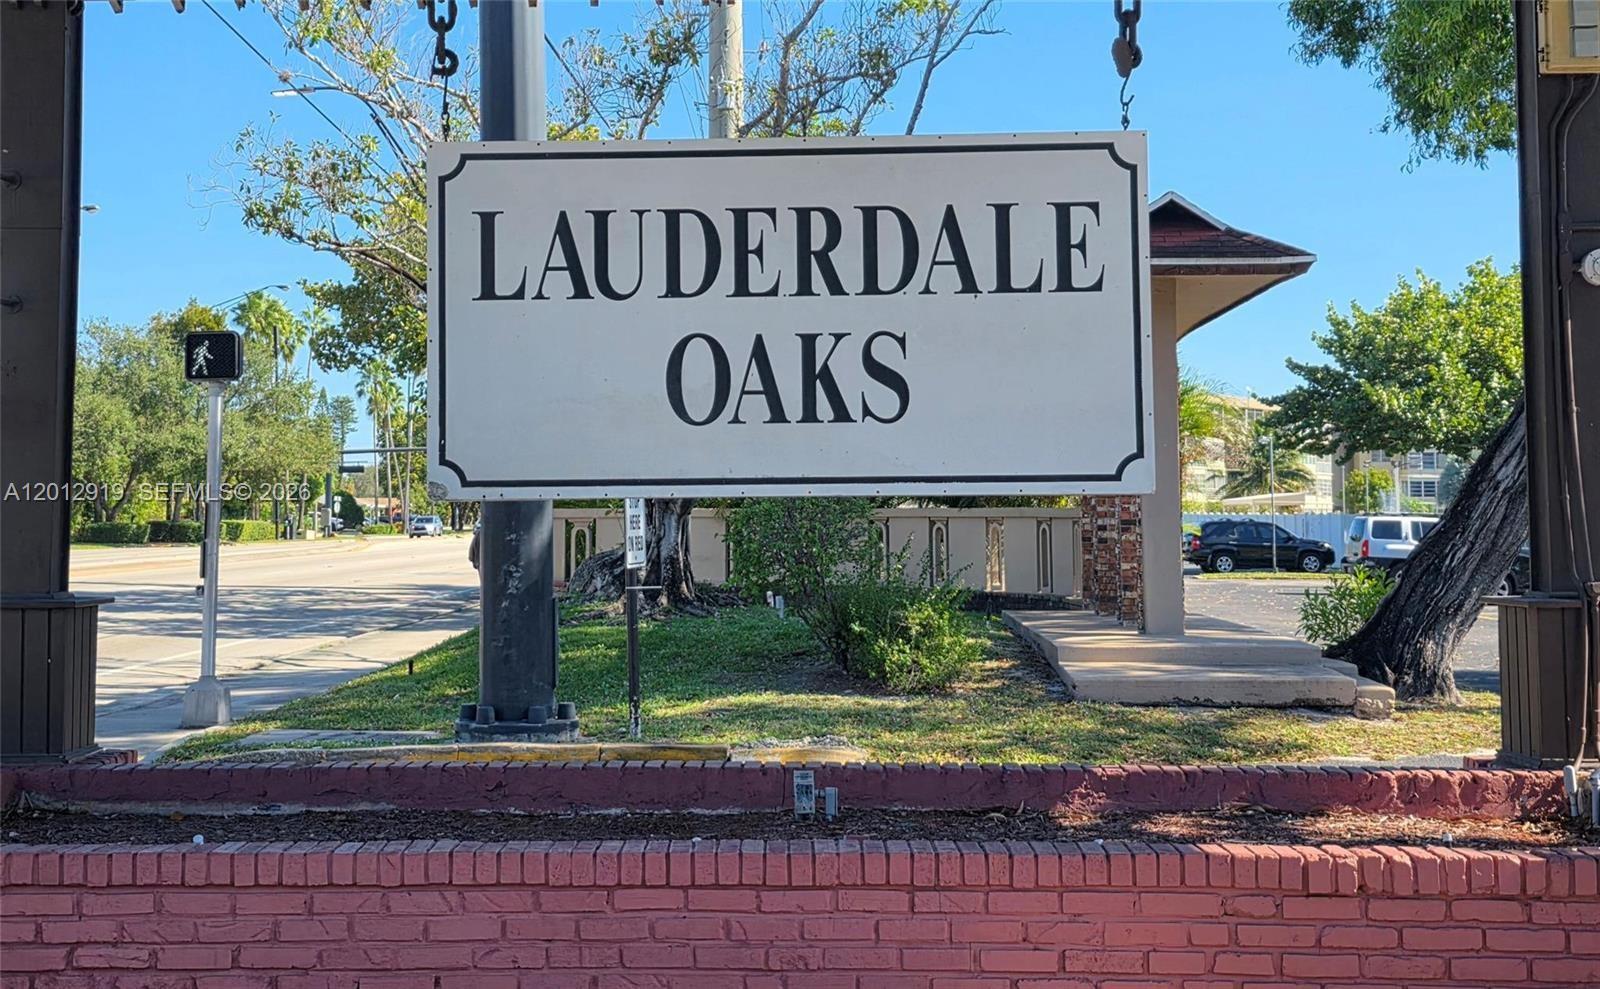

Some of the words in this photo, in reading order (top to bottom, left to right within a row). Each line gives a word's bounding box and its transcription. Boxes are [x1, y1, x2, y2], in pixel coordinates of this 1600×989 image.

[472, 201, 1105, 301] LAUDERDALE
[666, 331, 910, 427] OAKS
[629, 514, 641, 530] HERE
[634, 535, 644, 552] RED
